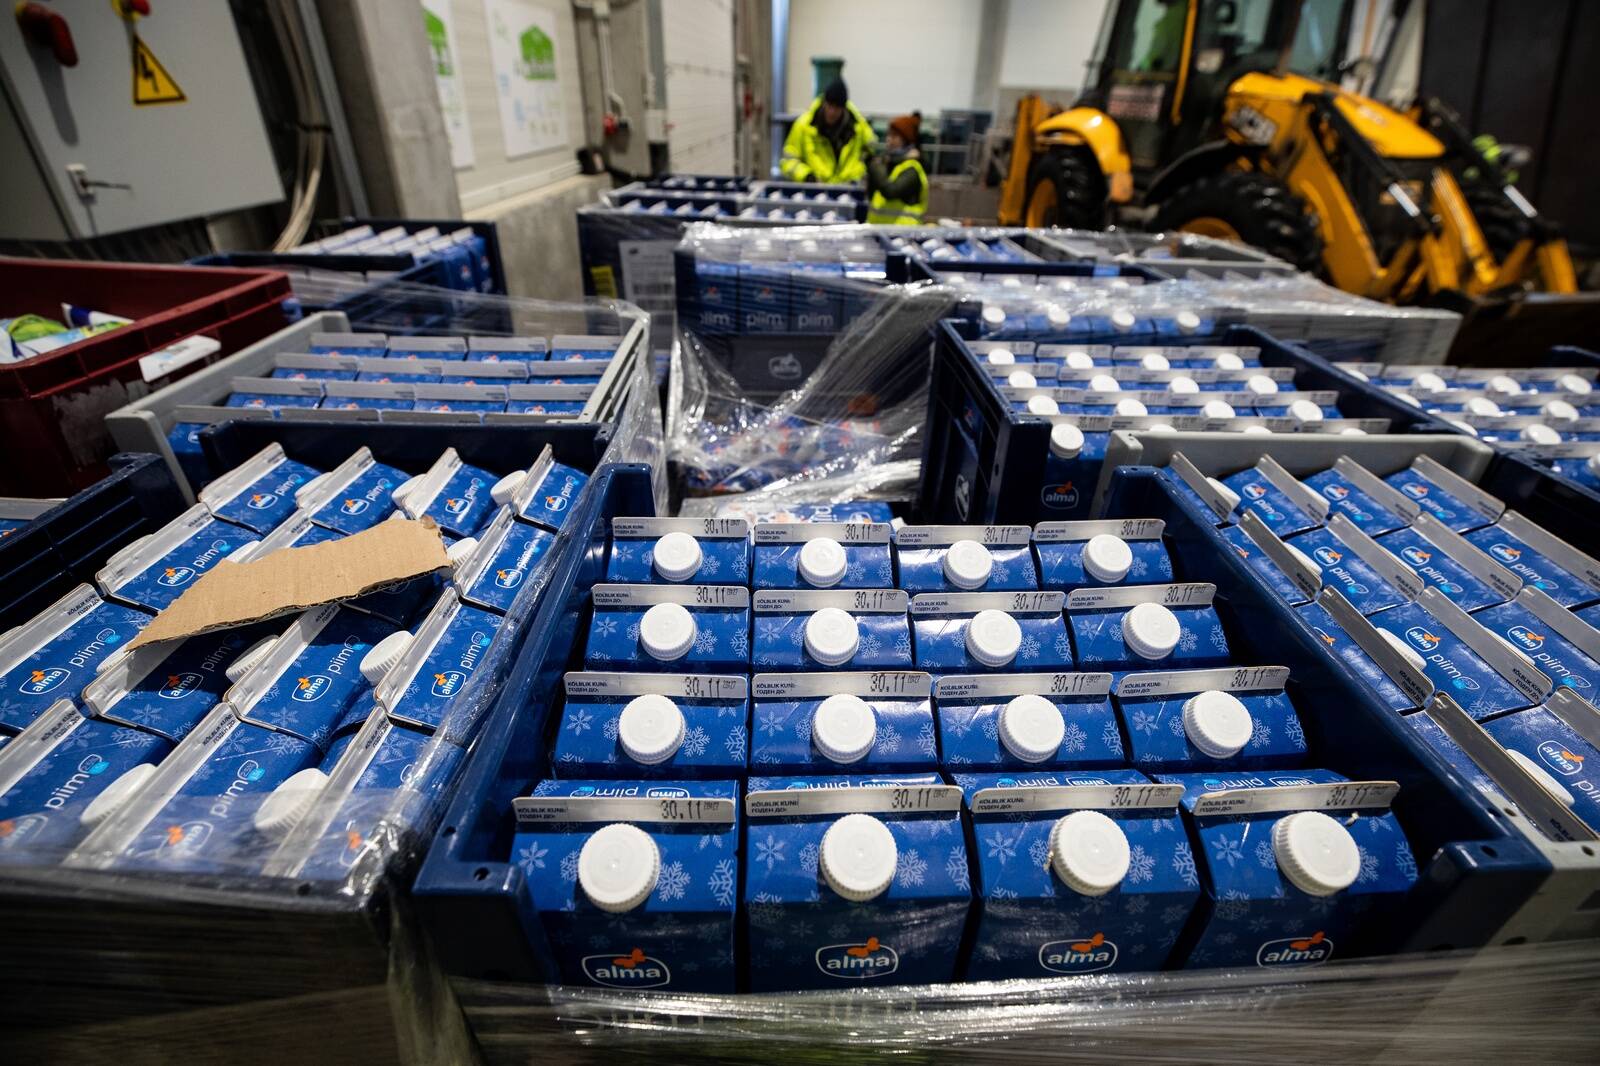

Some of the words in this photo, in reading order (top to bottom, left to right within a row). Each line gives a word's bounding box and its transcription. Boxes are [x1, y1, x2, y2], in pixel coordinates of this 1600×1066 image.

[704, 519, 729, 534] 30.11
[845, 523, 870, 540] 30.11
[984, 527, 1010, 543] 30.11
[1121, 520, 1146, 536] 30.11
[167, 568, 189, 585] alma
[193, 545, 219, 568] piim
[1511, 563, 1542, 582] piim
[1329, 567, 1355, 586] piim
[1420, 566, 1449, 585] piim
[696, 586, 725, 603] 30.11
[854, 592, 883, 609] 30.11
[1012, 593, 1043, 610] 30.11
[1164, 586, 1193, 603] 30.11
[1409, 629, 1431, 649] alma
[1427, 653, 1462, 679] piim
[1512, 628, 1536, 648] alma
[1532, 652, 1571, 677] piim
[32, 668, 61, 692] alma
[69, 640, 104, 668] piim
[170, 674, 195, 696] alma
[201, 644, 233, 672] piim
[303, 677, 324, 699] alma
[328, 648, 353, 674] piim
[442, 673, 459, 695] alma
[460, 644, 482, 670] piim
[684, 676, 720, 698] 30.11
[870, 673, 906, 693] 30.11
[1051, 674, 1086, 693] 30.11
[1231, 668, 1265, 687] 30.11
[1542, 745, 1574, 771] alma
[45, 771, 90, 810] piim
[1018, 777, 1060, 787] piim
[1222, 777, 1265, 788] piim
[210, 778, 249, 818] piim
[596, 787, 639, 797] piim
[891, 788, 931, 808] 30.11
[1111, 787, 1154, 806] 30.11
[1326, 786, 1369, 806] 30.11
[661, 800, 701, 819] 30.11
[827, 954, 890, 969] alma
[1047, 950, 1110, 964] alma
[1264, 949, 1325, 963] alma
[595, 965, 661, 980] alma
